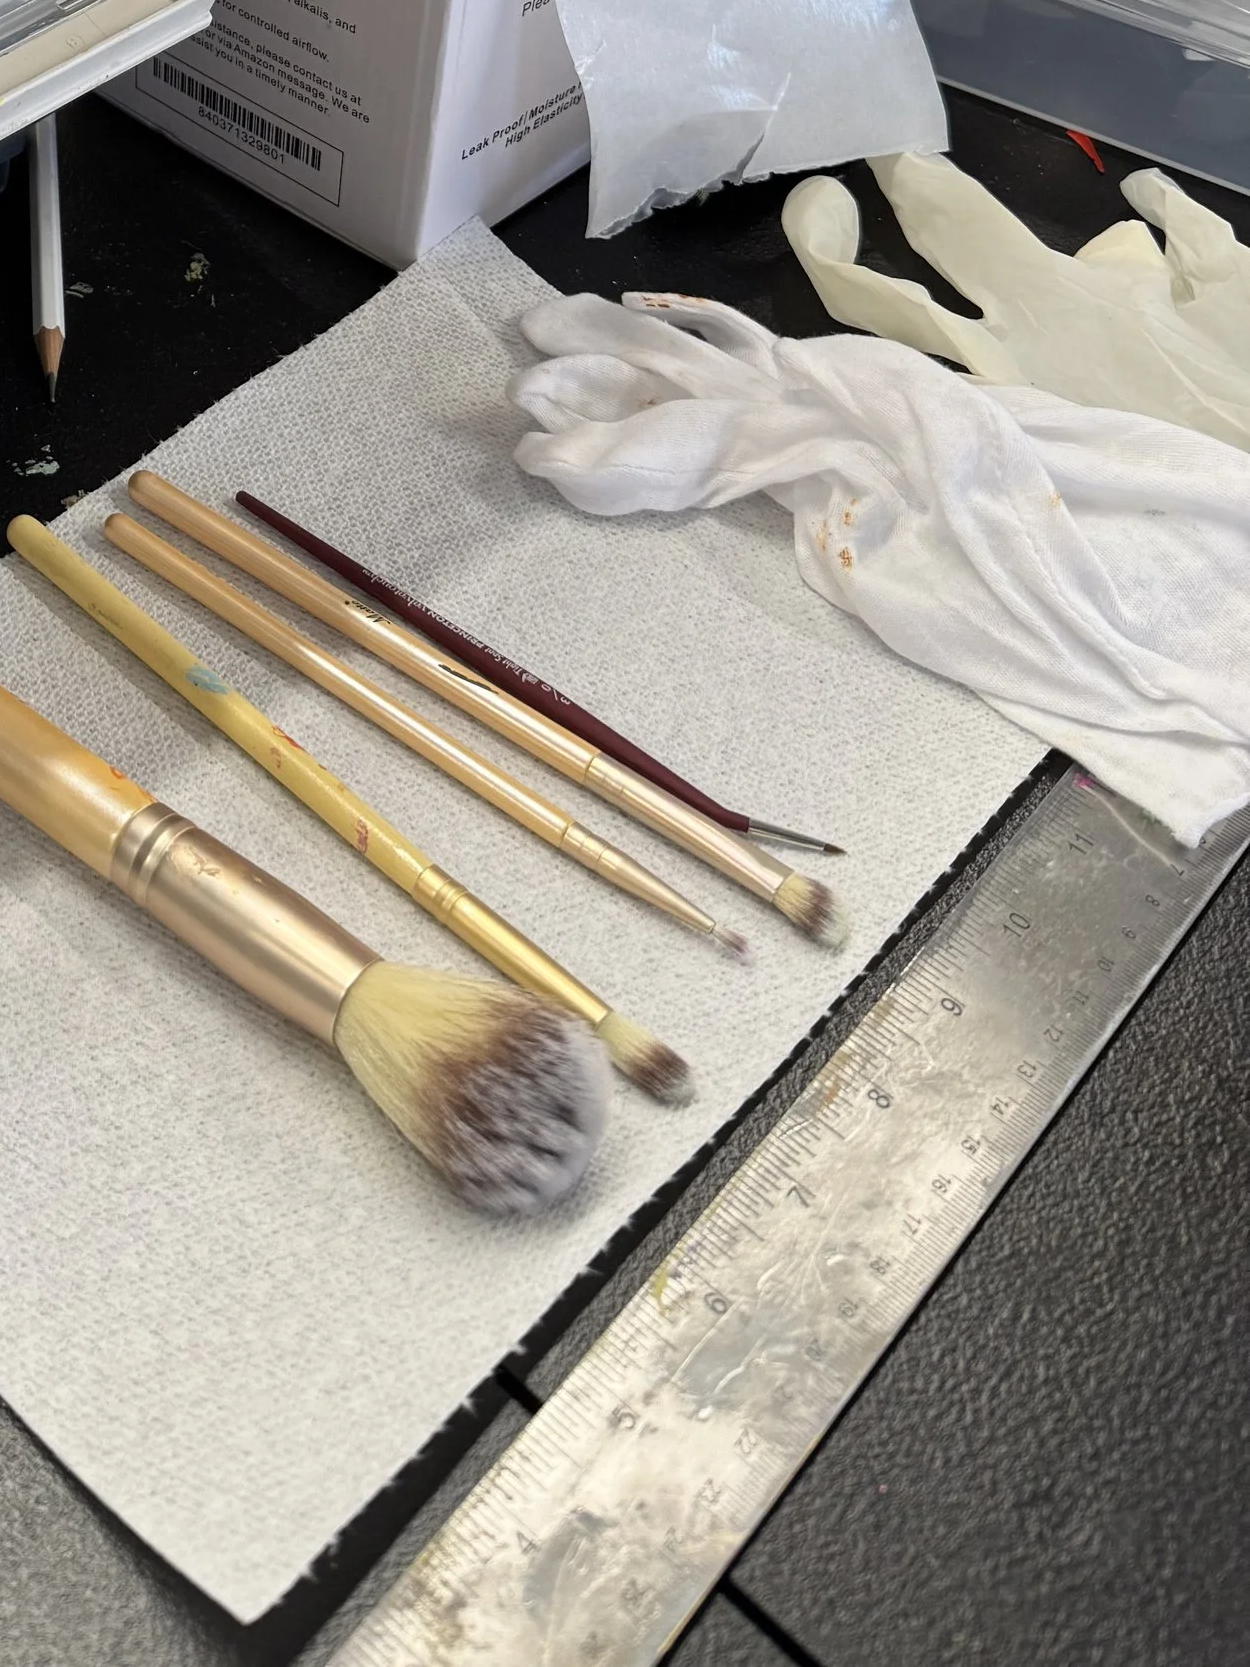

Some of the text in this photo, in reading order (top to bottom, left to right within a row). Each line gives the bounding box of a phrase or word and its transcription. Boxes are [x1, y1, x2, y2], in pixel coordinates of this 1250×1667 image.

[237, 9, 291, 42] controlled
[292, 36, 331, 63] airflow.
[335, 18, 357, 35] and
[214, 48, 234, 66] you
[234, 55, 245, 69] in
[254, 68, 287, 94] timely
[288, 87, 332, 118] manner.
[218, 33, 232, 51] via
[233, 42, 276, 74] Amazon
[276, 68, 329, 101] message.
[330, 94, 350, 113] We
[350, 108, 371, 125] are
[255, 43, 292, 68] please
[293, 63, 334, 91] contact
[334, 84, 349, 100] us
[349, 92, 362, 106] at
[461, 83, 577, 161] Leak Moisture
[505, 91, 584, 149] High Elasticity
[427, 609, 486, 650] PRINCETON
[1144, 894, 1161, 908] 8
[1121, 927, 1137, 940] 9
[1097, 955, 1116, 974] 10
[1073, 990, 1091, 1006] 11
[1043, 1025, 1064, 1043] 12
[1017, 1060, 1038, 1080] 13
[990, 1096, 1010, 1118] 14
[959, 1137, 982, 1157] 15
[515, 832, 1096, 1555] 4 5 6 7 8 9 10 11
[931, 1173, 954, 1194] 16
[902, 1213, 923, 1236] 17
